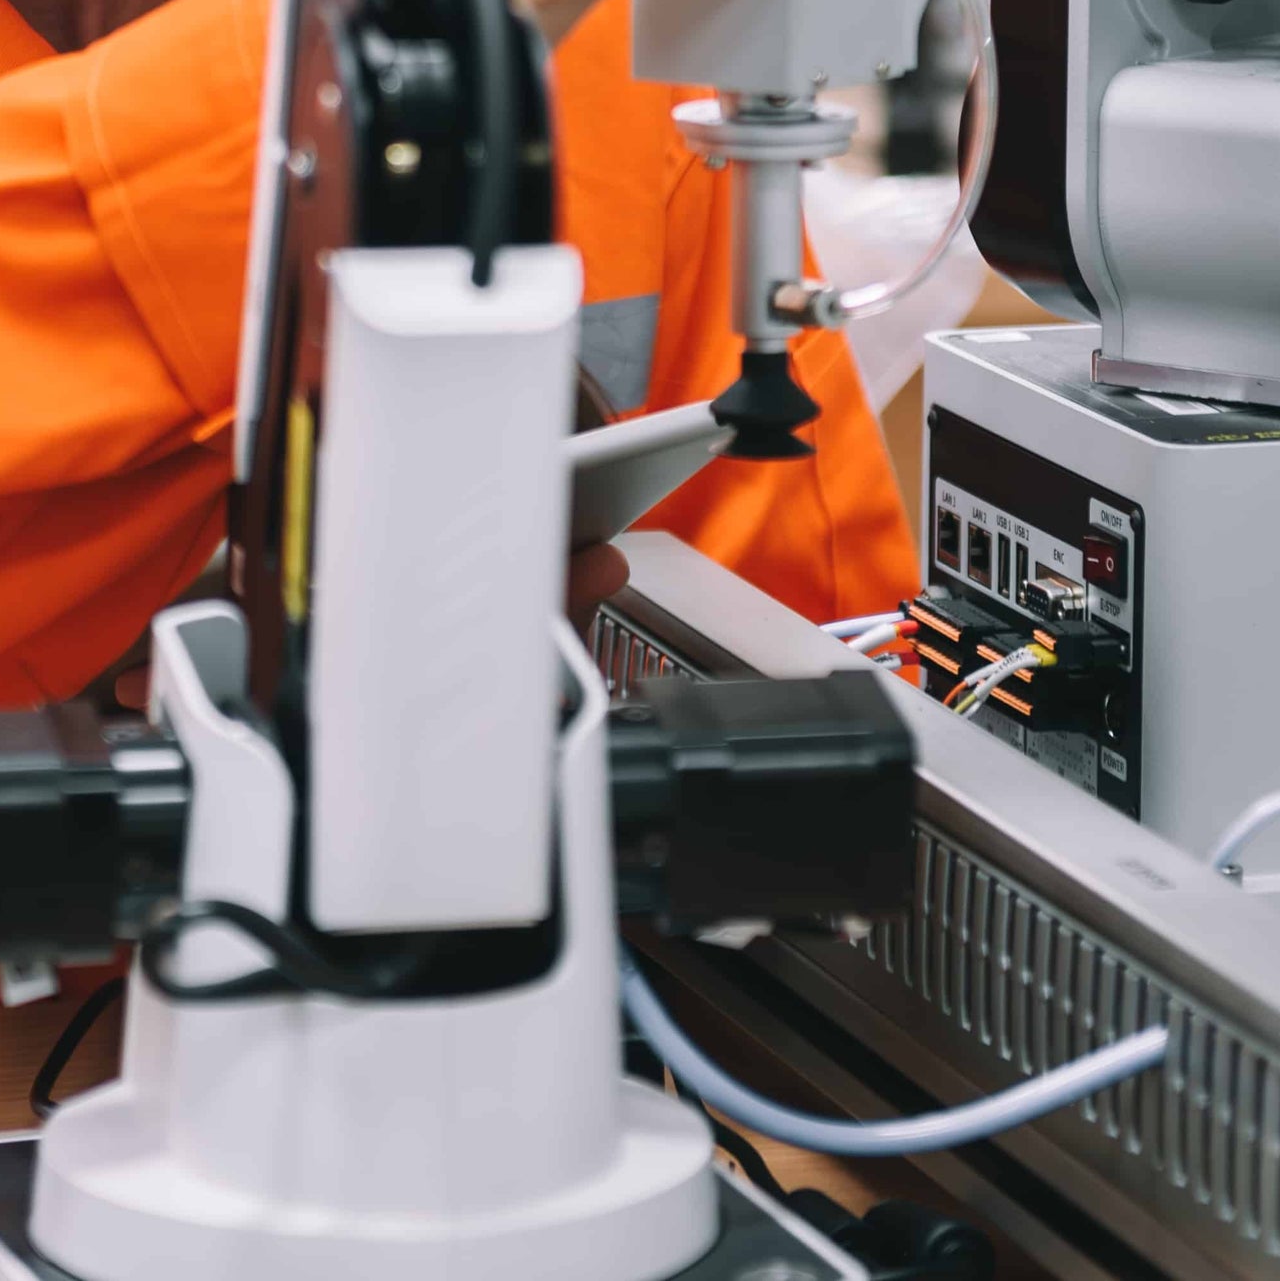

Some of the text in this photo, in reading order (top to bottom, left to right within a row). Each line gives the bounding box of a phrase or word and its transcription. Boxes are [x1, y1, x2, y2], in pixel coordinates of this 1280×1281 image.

[942, 491, 953, 506] LAN
[972, 507, 983, 523] LAN
[996, 514, 1008, 530] USB
[1100, 509, 1123, 531] ON/OFF
[1014, 523, 1026, 539] USB
[1053, 548, 1065, 565] ENC
[1100, 597, 1121, 618] E-STOP
[1103, 751, 1126, 776] POWER
